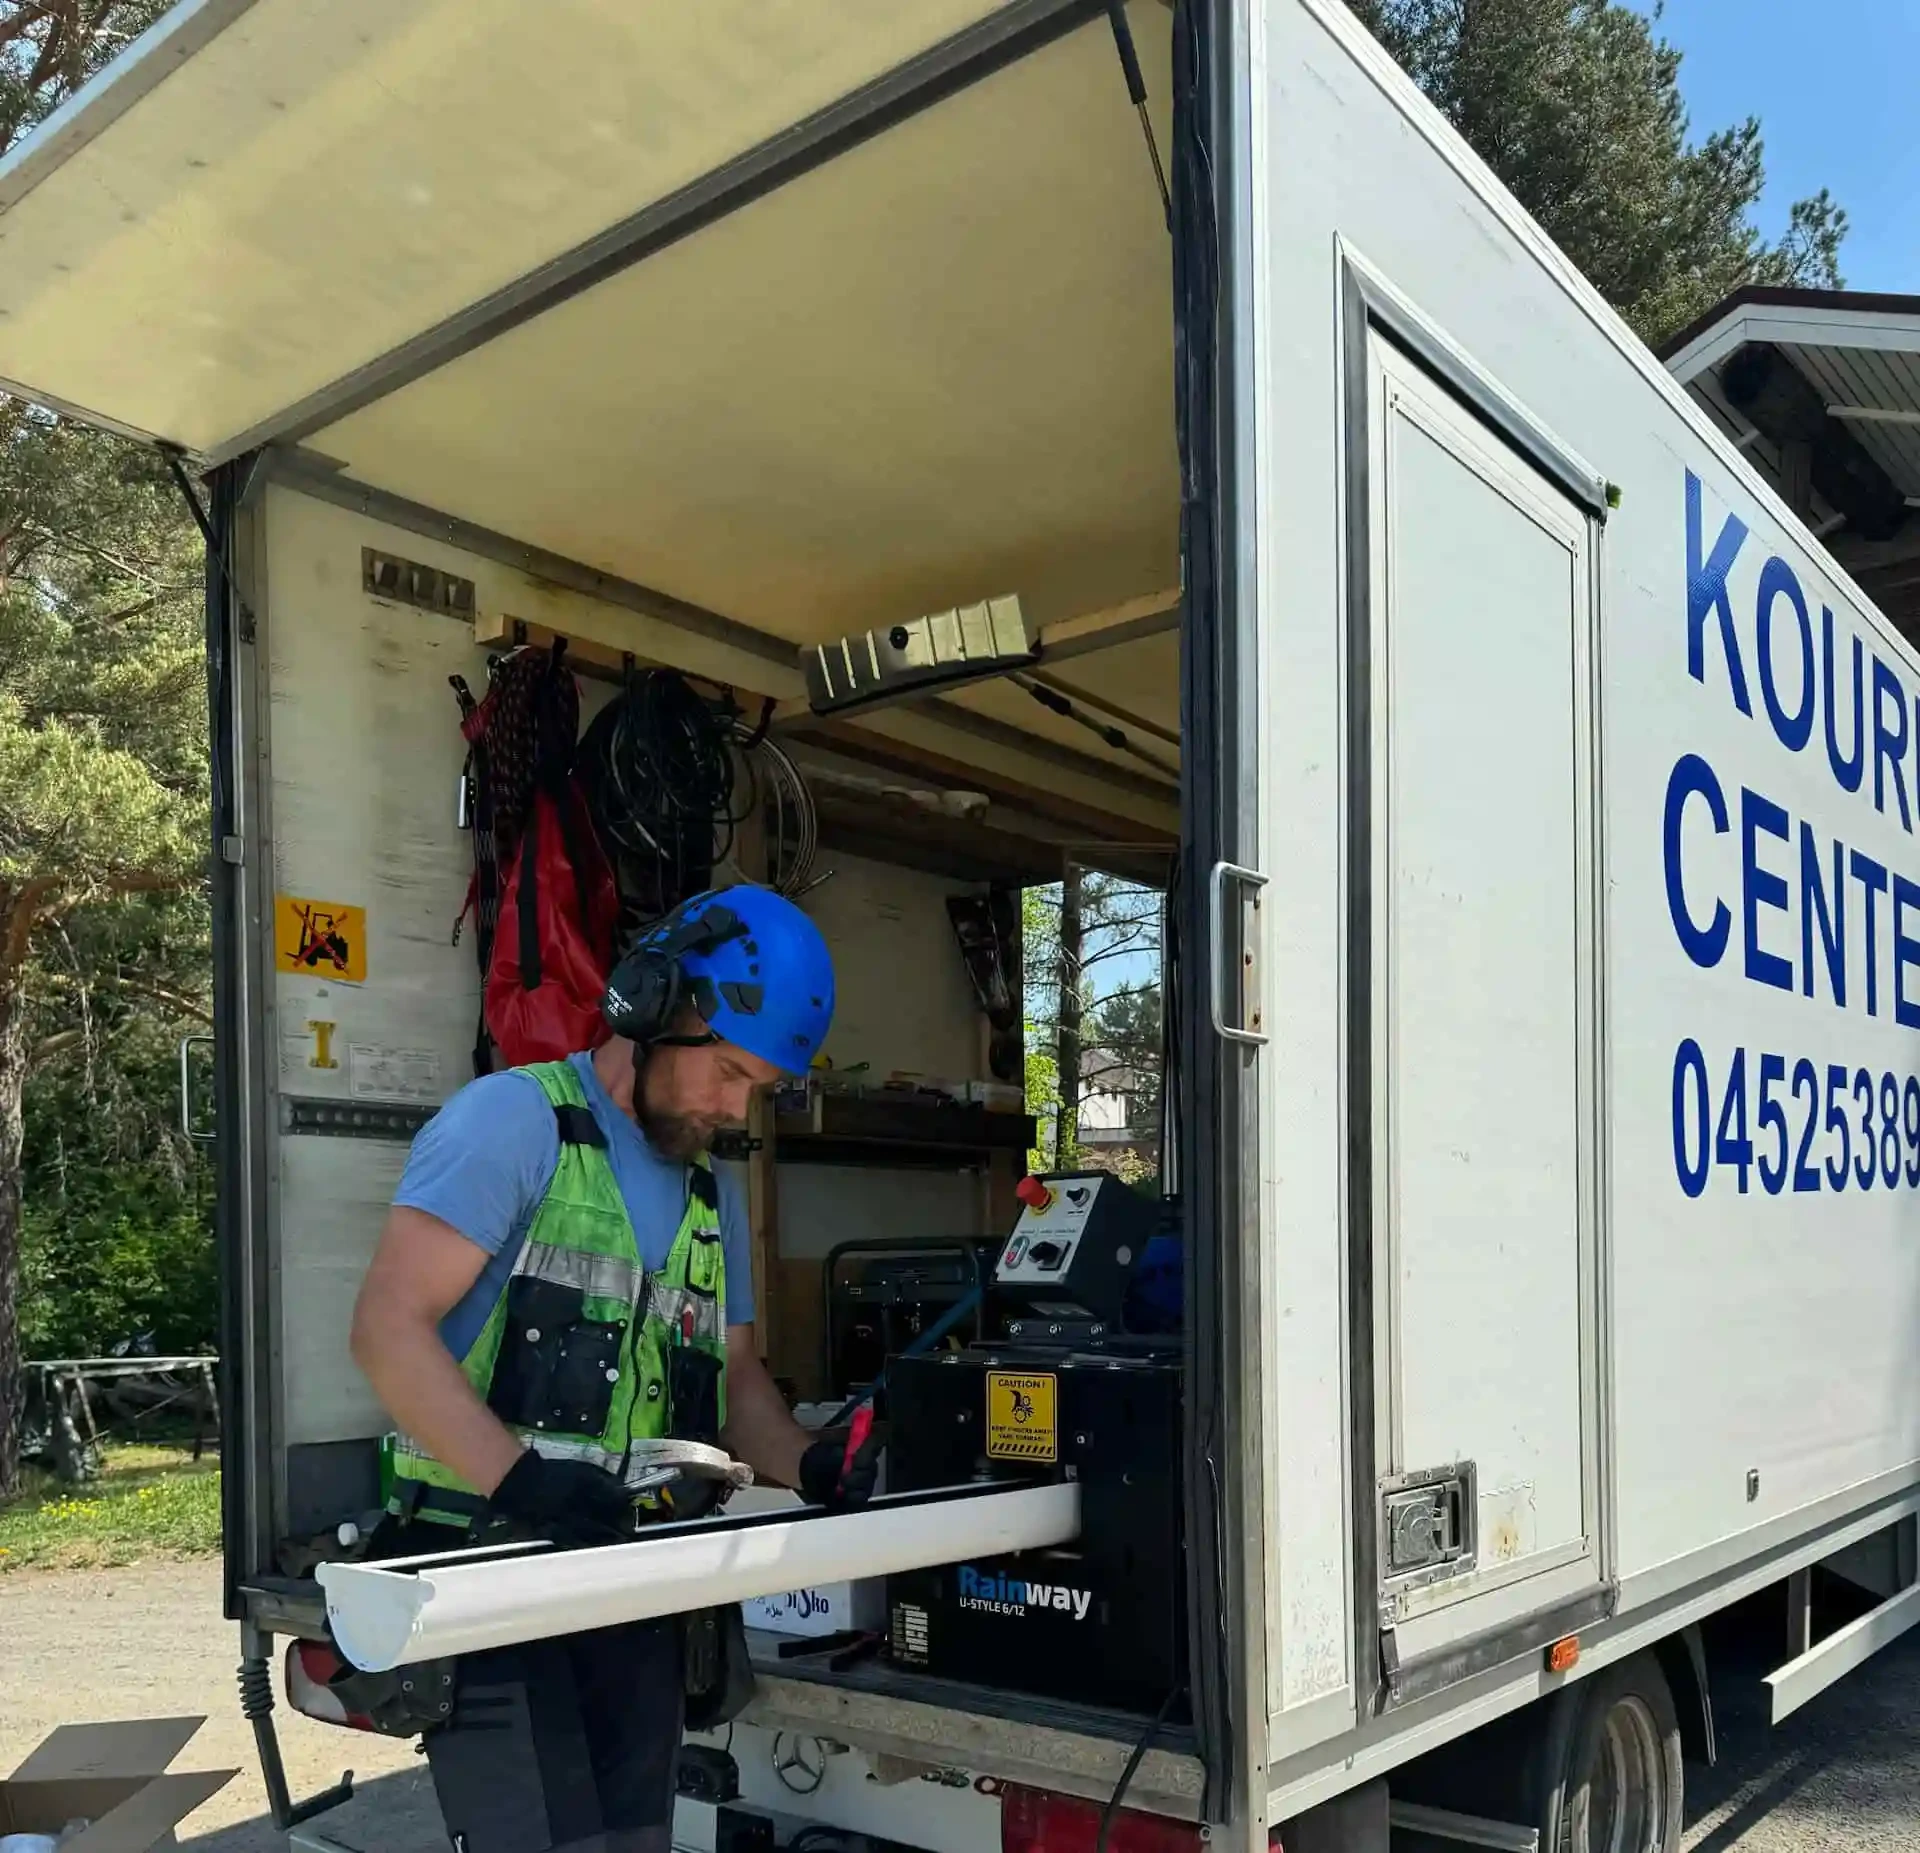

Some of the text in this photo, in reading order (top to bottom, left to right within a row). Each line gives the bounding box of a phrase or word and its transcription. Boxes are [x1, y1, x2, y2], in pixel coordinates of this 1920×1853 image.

[1685, 465, 1920, 838] KOUR
[957, 1565, 1091, 1621] Rainway
[959, 1596, 1000, 1613] U-STYLE
